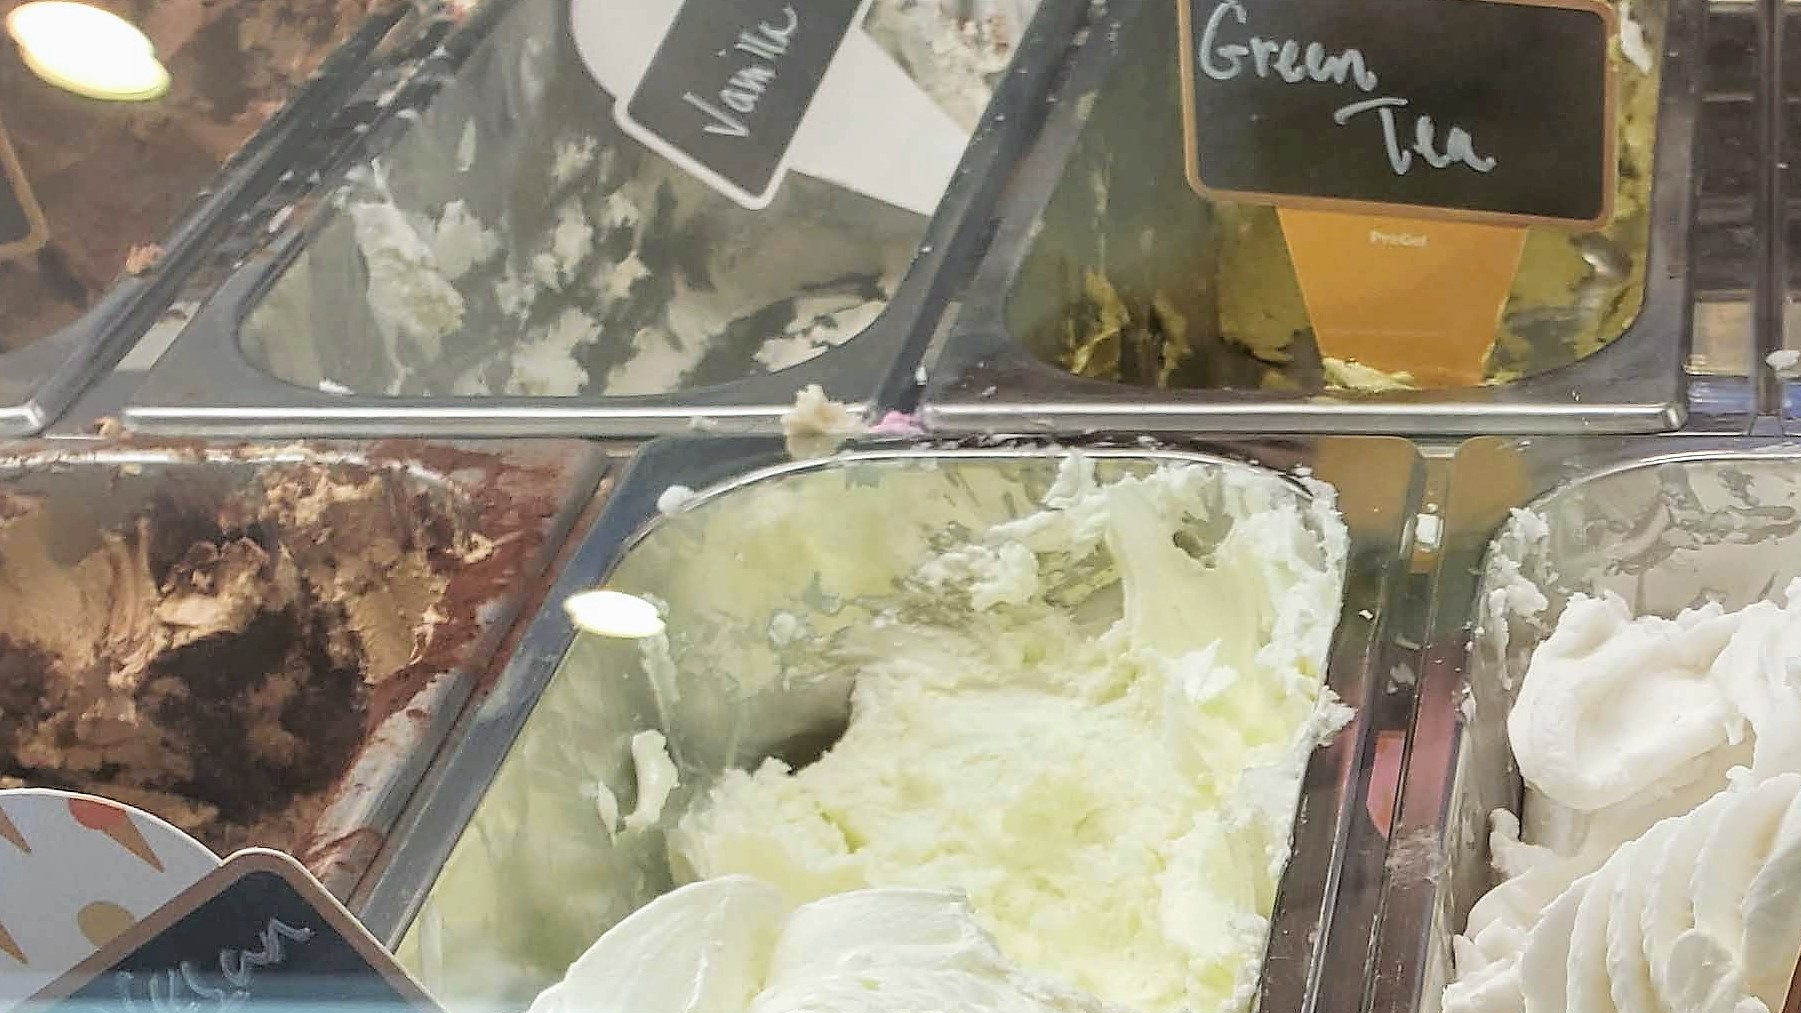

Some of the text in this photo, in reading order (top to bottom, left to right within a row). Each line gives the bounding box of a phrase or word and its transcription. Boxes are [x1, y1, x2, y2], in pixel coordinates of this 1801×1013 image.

[682, 4, 799, 138] Vanilla
[1200, 1, 1379, 93] Green
[1334, 96, 1498, 176] Tea
